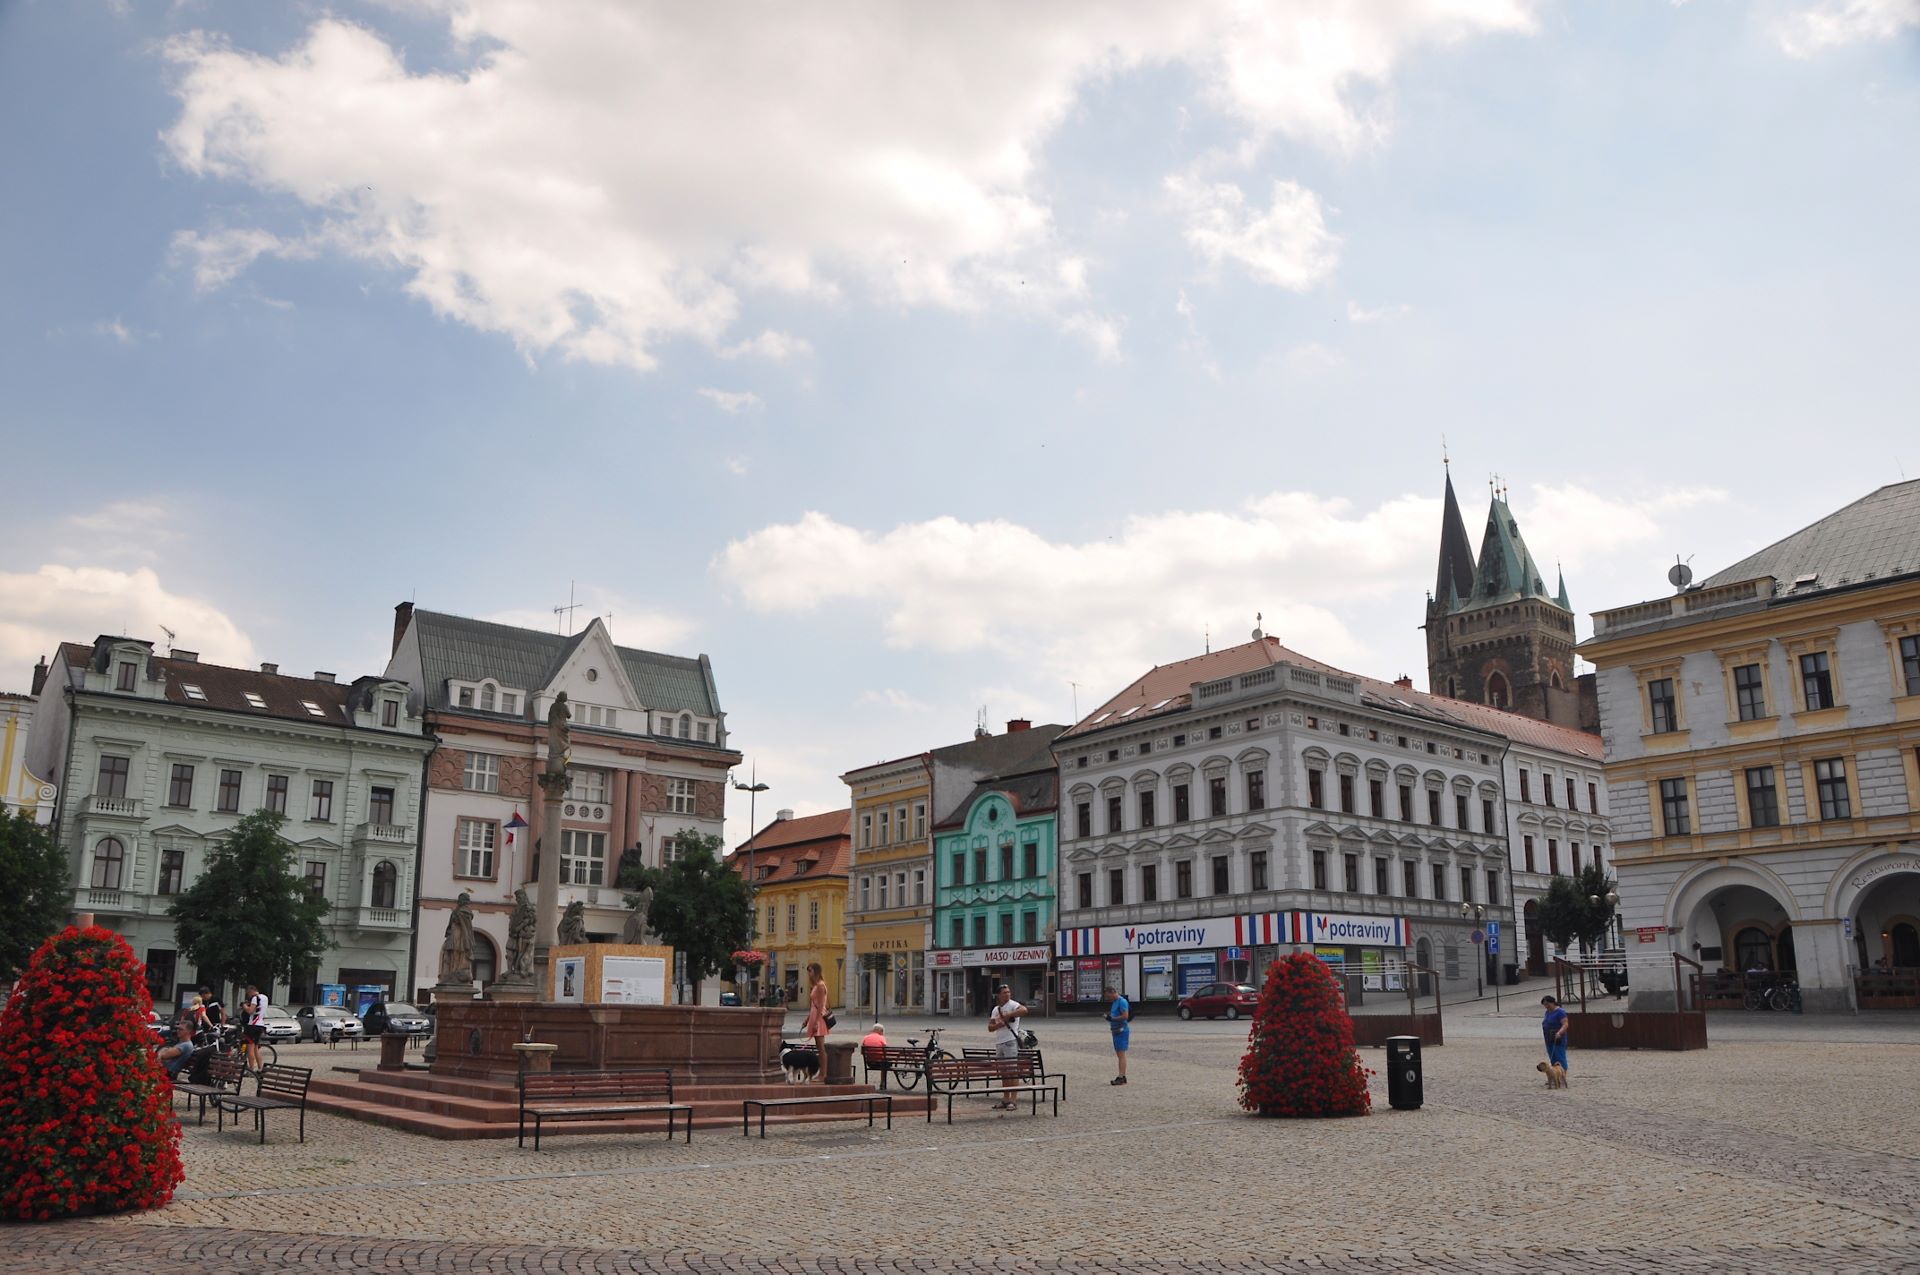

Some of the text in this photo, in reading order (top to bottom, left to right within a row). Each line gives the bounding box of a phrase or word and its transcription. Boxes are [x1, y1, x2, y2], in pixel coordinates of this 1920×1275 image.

[1851, 860, 1910, 889] Restaurant
[1137, 925, 1205, 949] potraviny
[1330, 921, 1391, 943] potraviny
[872, 939, 908, 949] OPTIKA
[985, 951, 1009, 962] MASO
[1012, 949, 1046, 961] UZENINY
